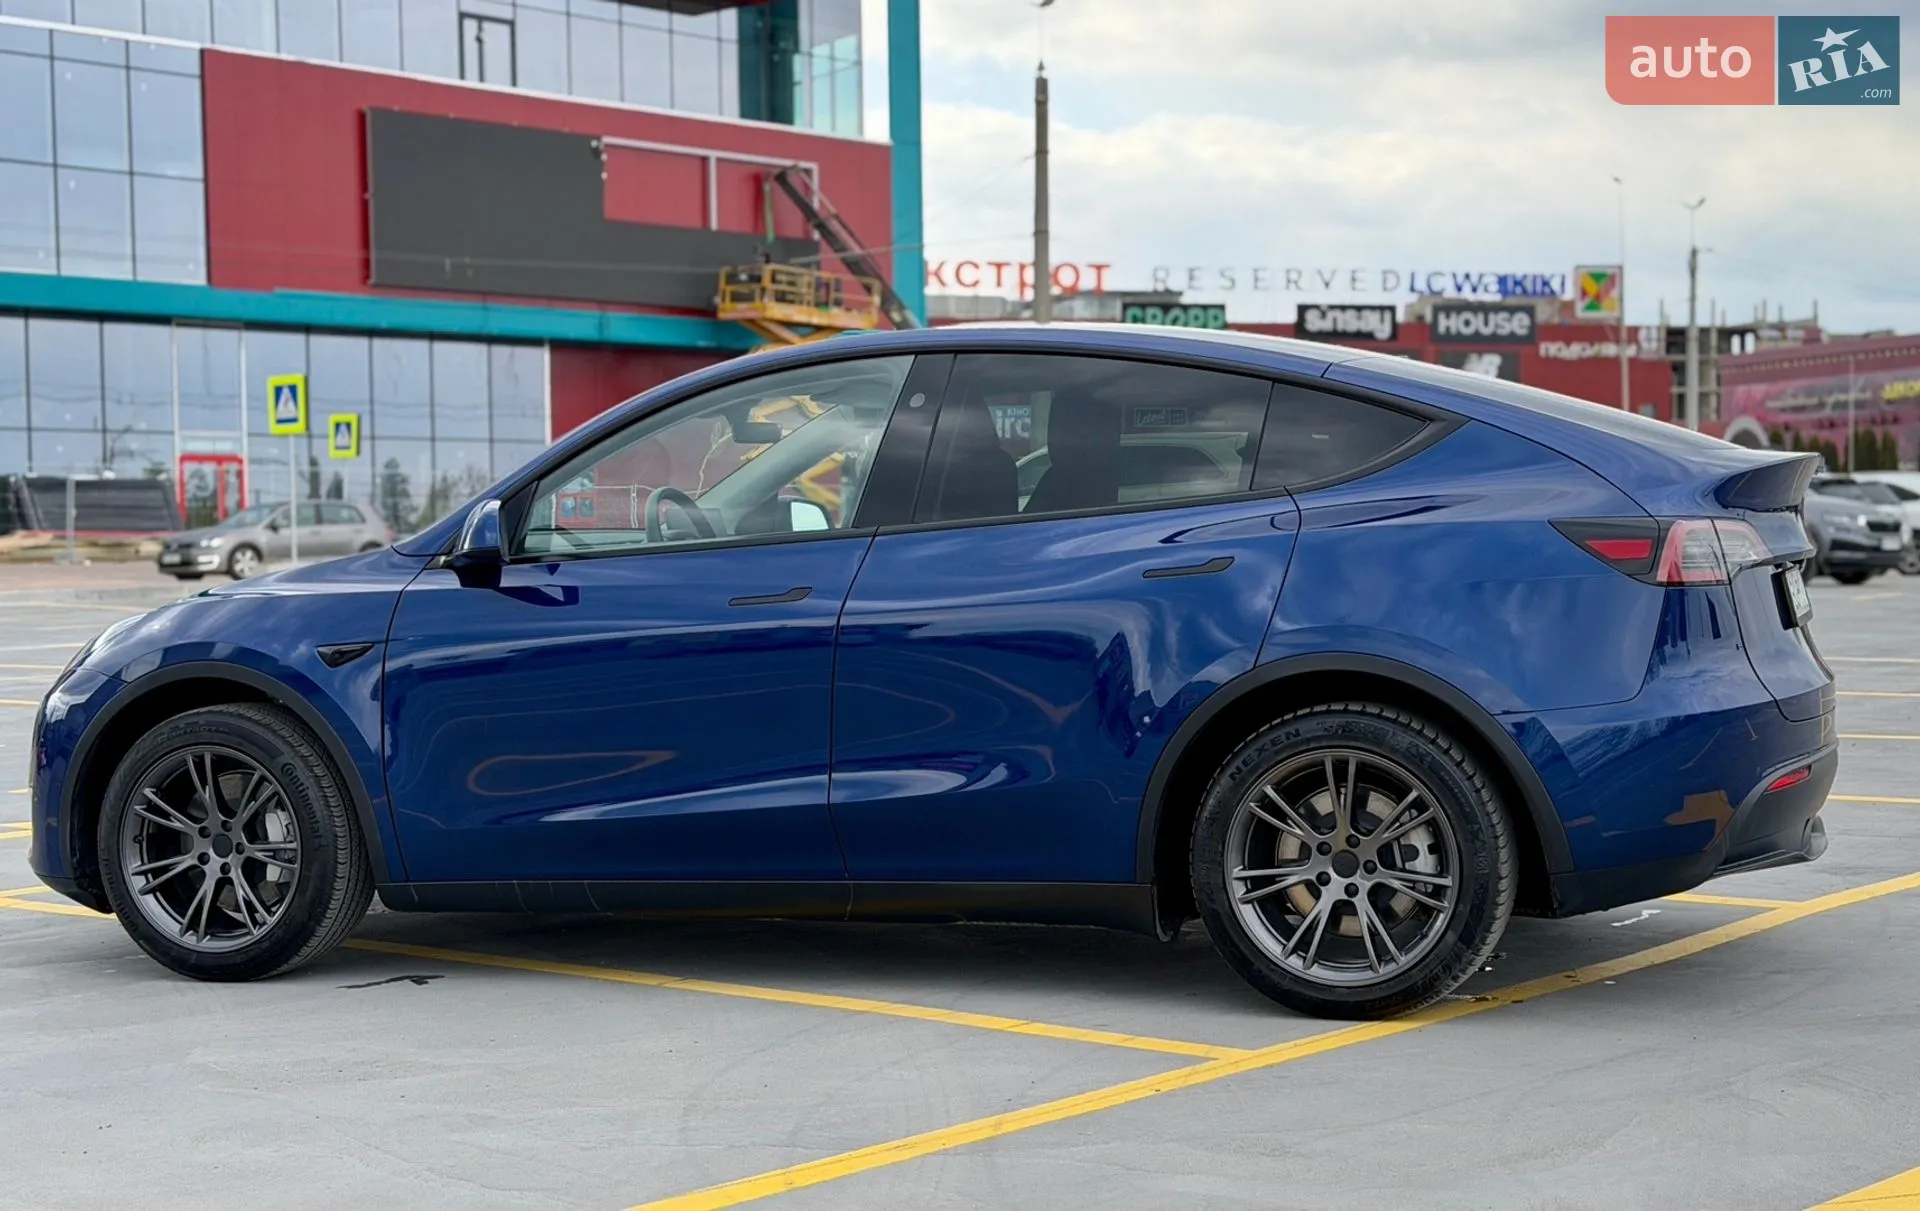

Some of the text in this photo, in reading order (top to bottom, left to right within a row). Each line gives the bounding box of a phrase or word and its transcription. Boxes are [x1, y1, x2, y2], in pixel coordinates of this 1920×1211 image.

[1153, 266, 1401, 293] RESERVED
[1125, 306, 1225, 328] CROPP
[1304, 304, 1392, 340] sinsay
[1228, 728, 1301, 782] NEXEN
[281, 762, 322, 839] Continental
